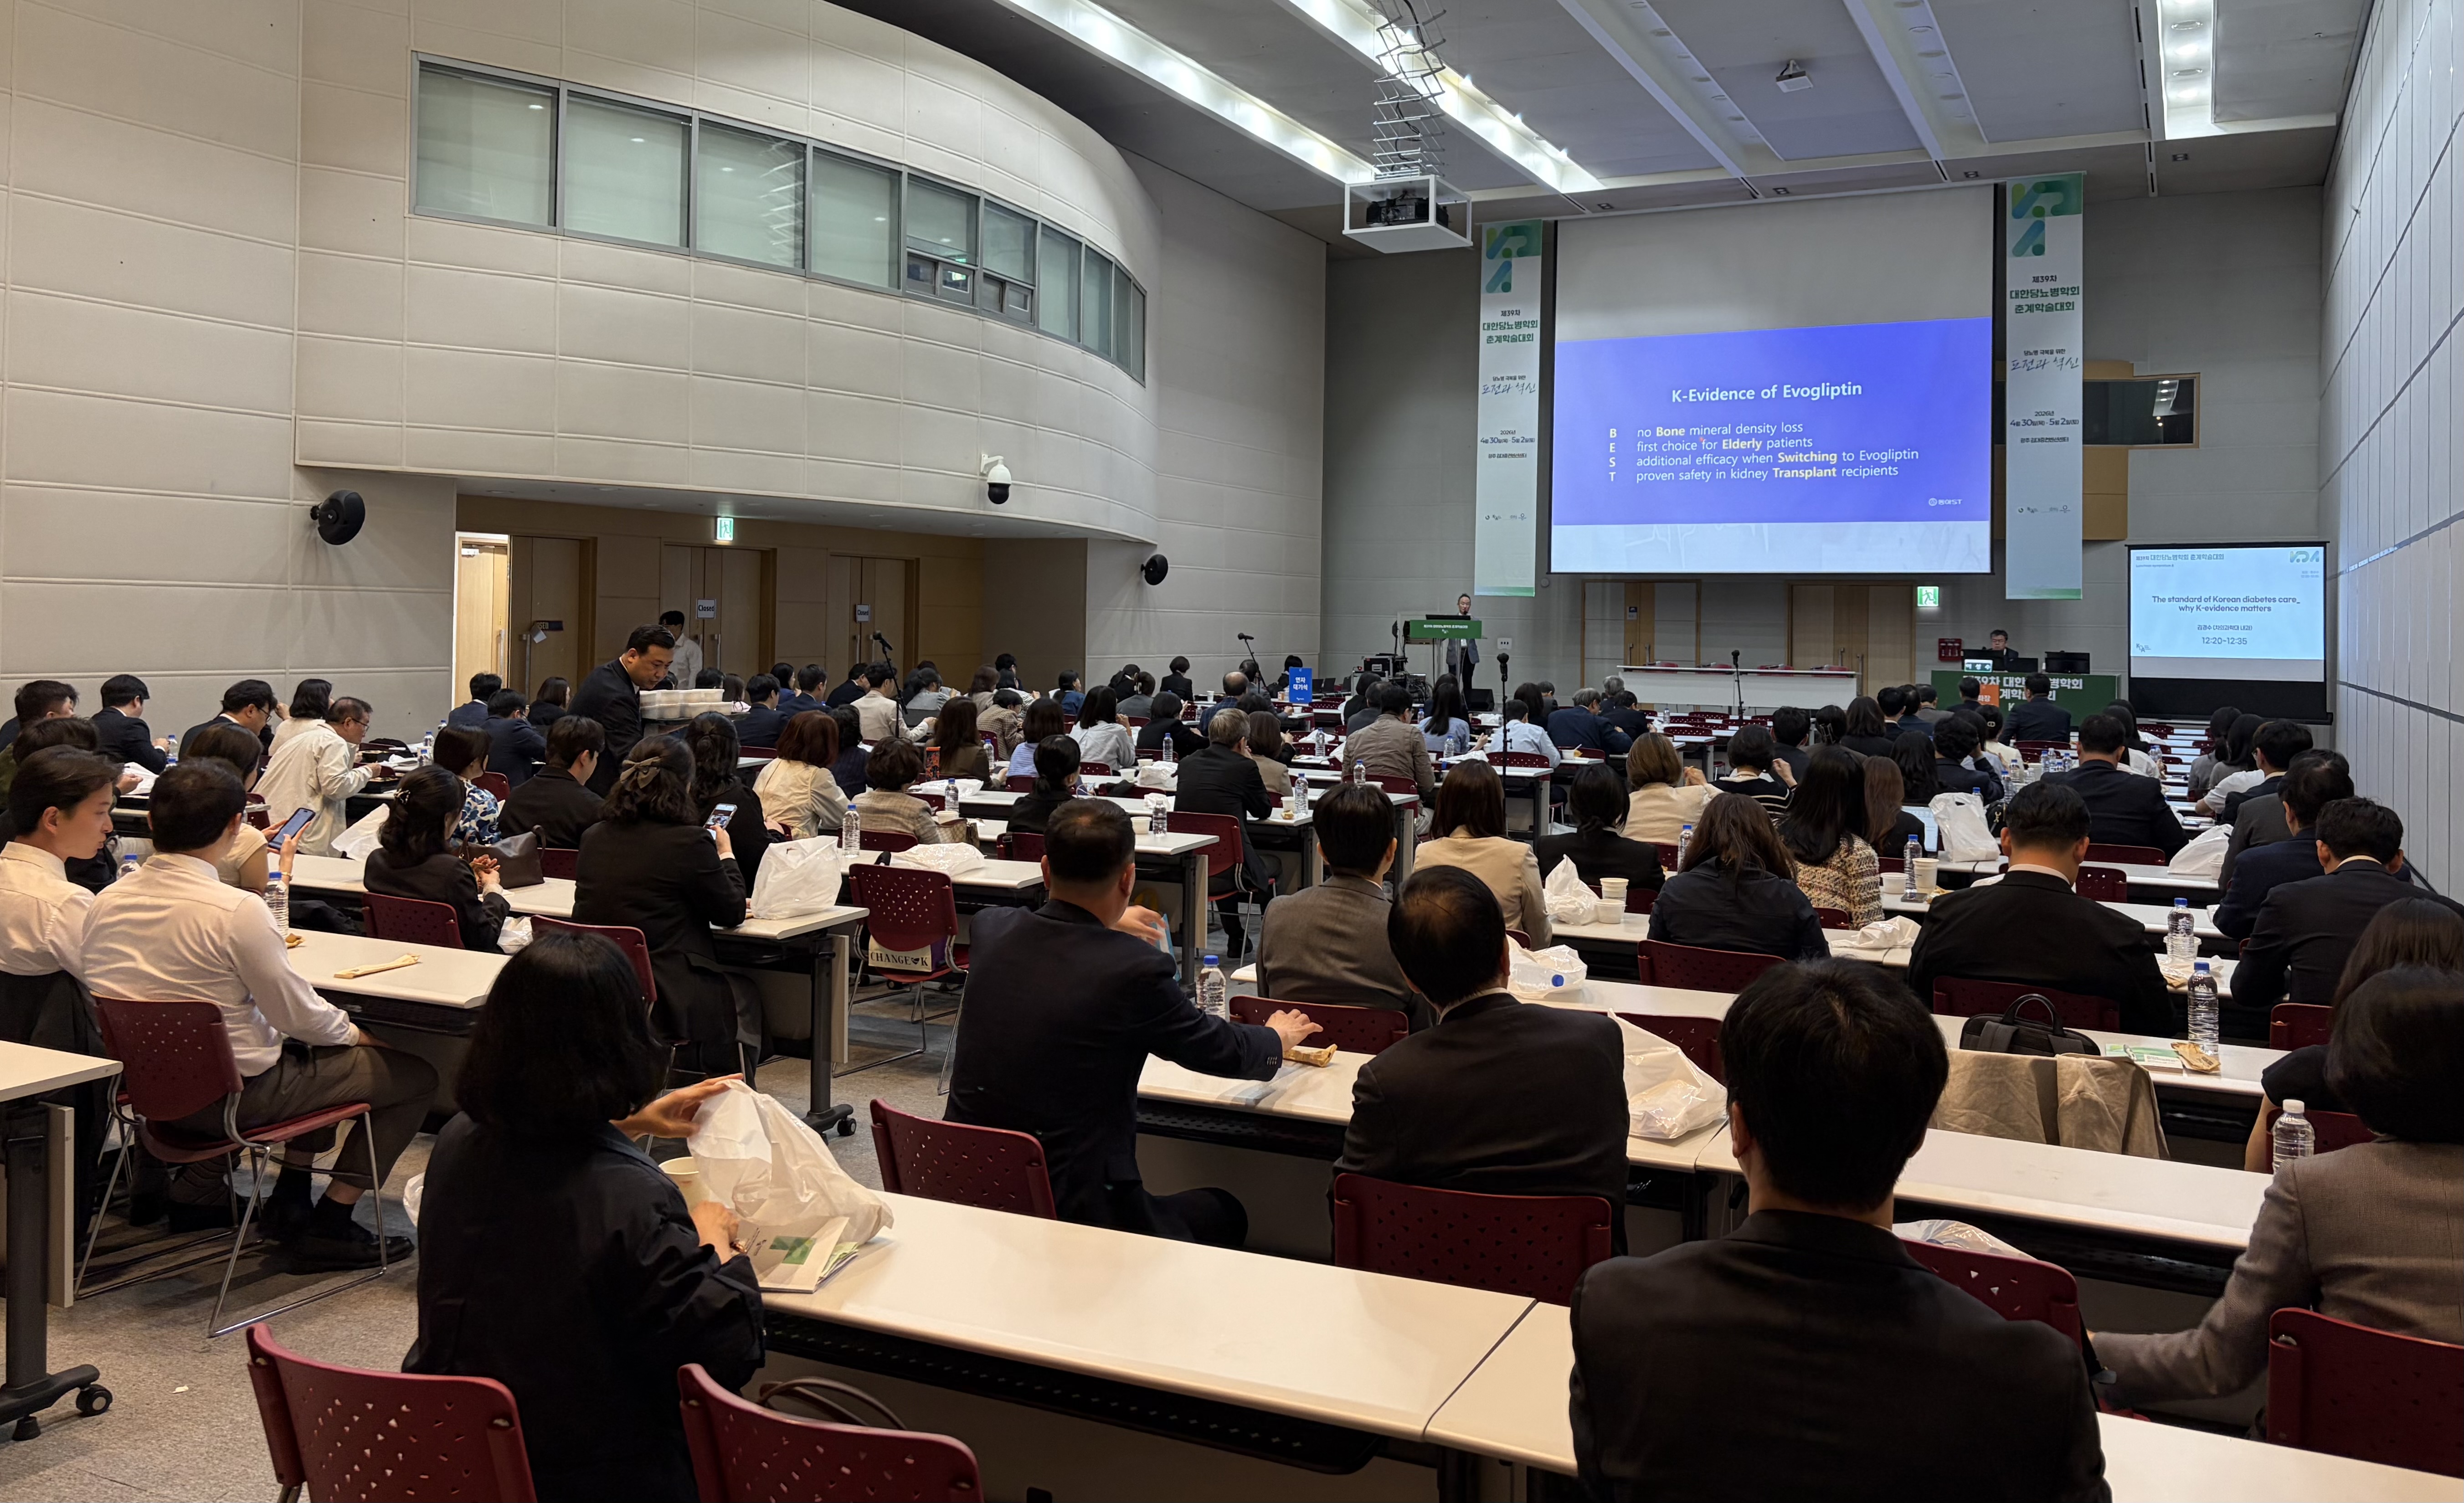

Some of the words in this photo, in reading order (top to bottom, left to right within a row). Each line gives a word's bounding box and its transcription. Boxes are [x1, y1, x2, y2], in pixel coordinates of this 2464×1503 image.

[2010, 286, 2079, 299] 대한당뇨병학회
[2015, 301, 2074, 313] 춘계학술대회
[1482, 319, 1538, 331] 대한당뇨병학회
[1487, 333, 1533, 344] 춘계학술대회
[2011, 359, 2050, 371] 도전과
[2053, 357, 2079, 371] 혁신
[1481, 383, 1513, 395] 도전과
[1516, 382, 1536, 395] 혁신
[1672, 387, 1755, 403] K-Evidence
[1760, 385, 1778, 399] of
[1783, 381, 1862, 400] Evogliptin
[1610, 428, 1617, 438] B
[1637, 429, 1651, 437] no
[1656, 426, 1685, 437] Bone
[1689, 424, 1731, 436] mineral
[1736, 423, 1777, 436] density
[1781, 422, 1803, 433] loss
[1610, 442, 1616, 452] E
[1637, 441, 1658, 451] first
[1662, 441, 1698, 451] choice
[1702, 439, 1718, 450] for
[1722, 438, 1762, 451] Elderly
[1767, 437, 1813, 451] patients
[1609, 457, 1616, 467] S
[1636, 455, 1691, 467] additional
[1696, 454, 1738, 467] efficacy
[1742, 453, 1773, 463] when
[1778, 451, 1837, 464] Switching
[1842, 451, 1855, 461] to
[1860, 449, 1919, 463] Evogliptin
[1609, 472, 1616, 482] T
[1636, 472, 1674, 483] proven
[1679, 470, 1712, 483] safety
[1716, 469, 1726, 479] in
[1731, 468, 1768, 481] kidney
[1772, 467, 1837, 480] Transplant
[1842, 465, 1898, 479] recipients
[2003, 677, 2083, 689] 대한병학회
